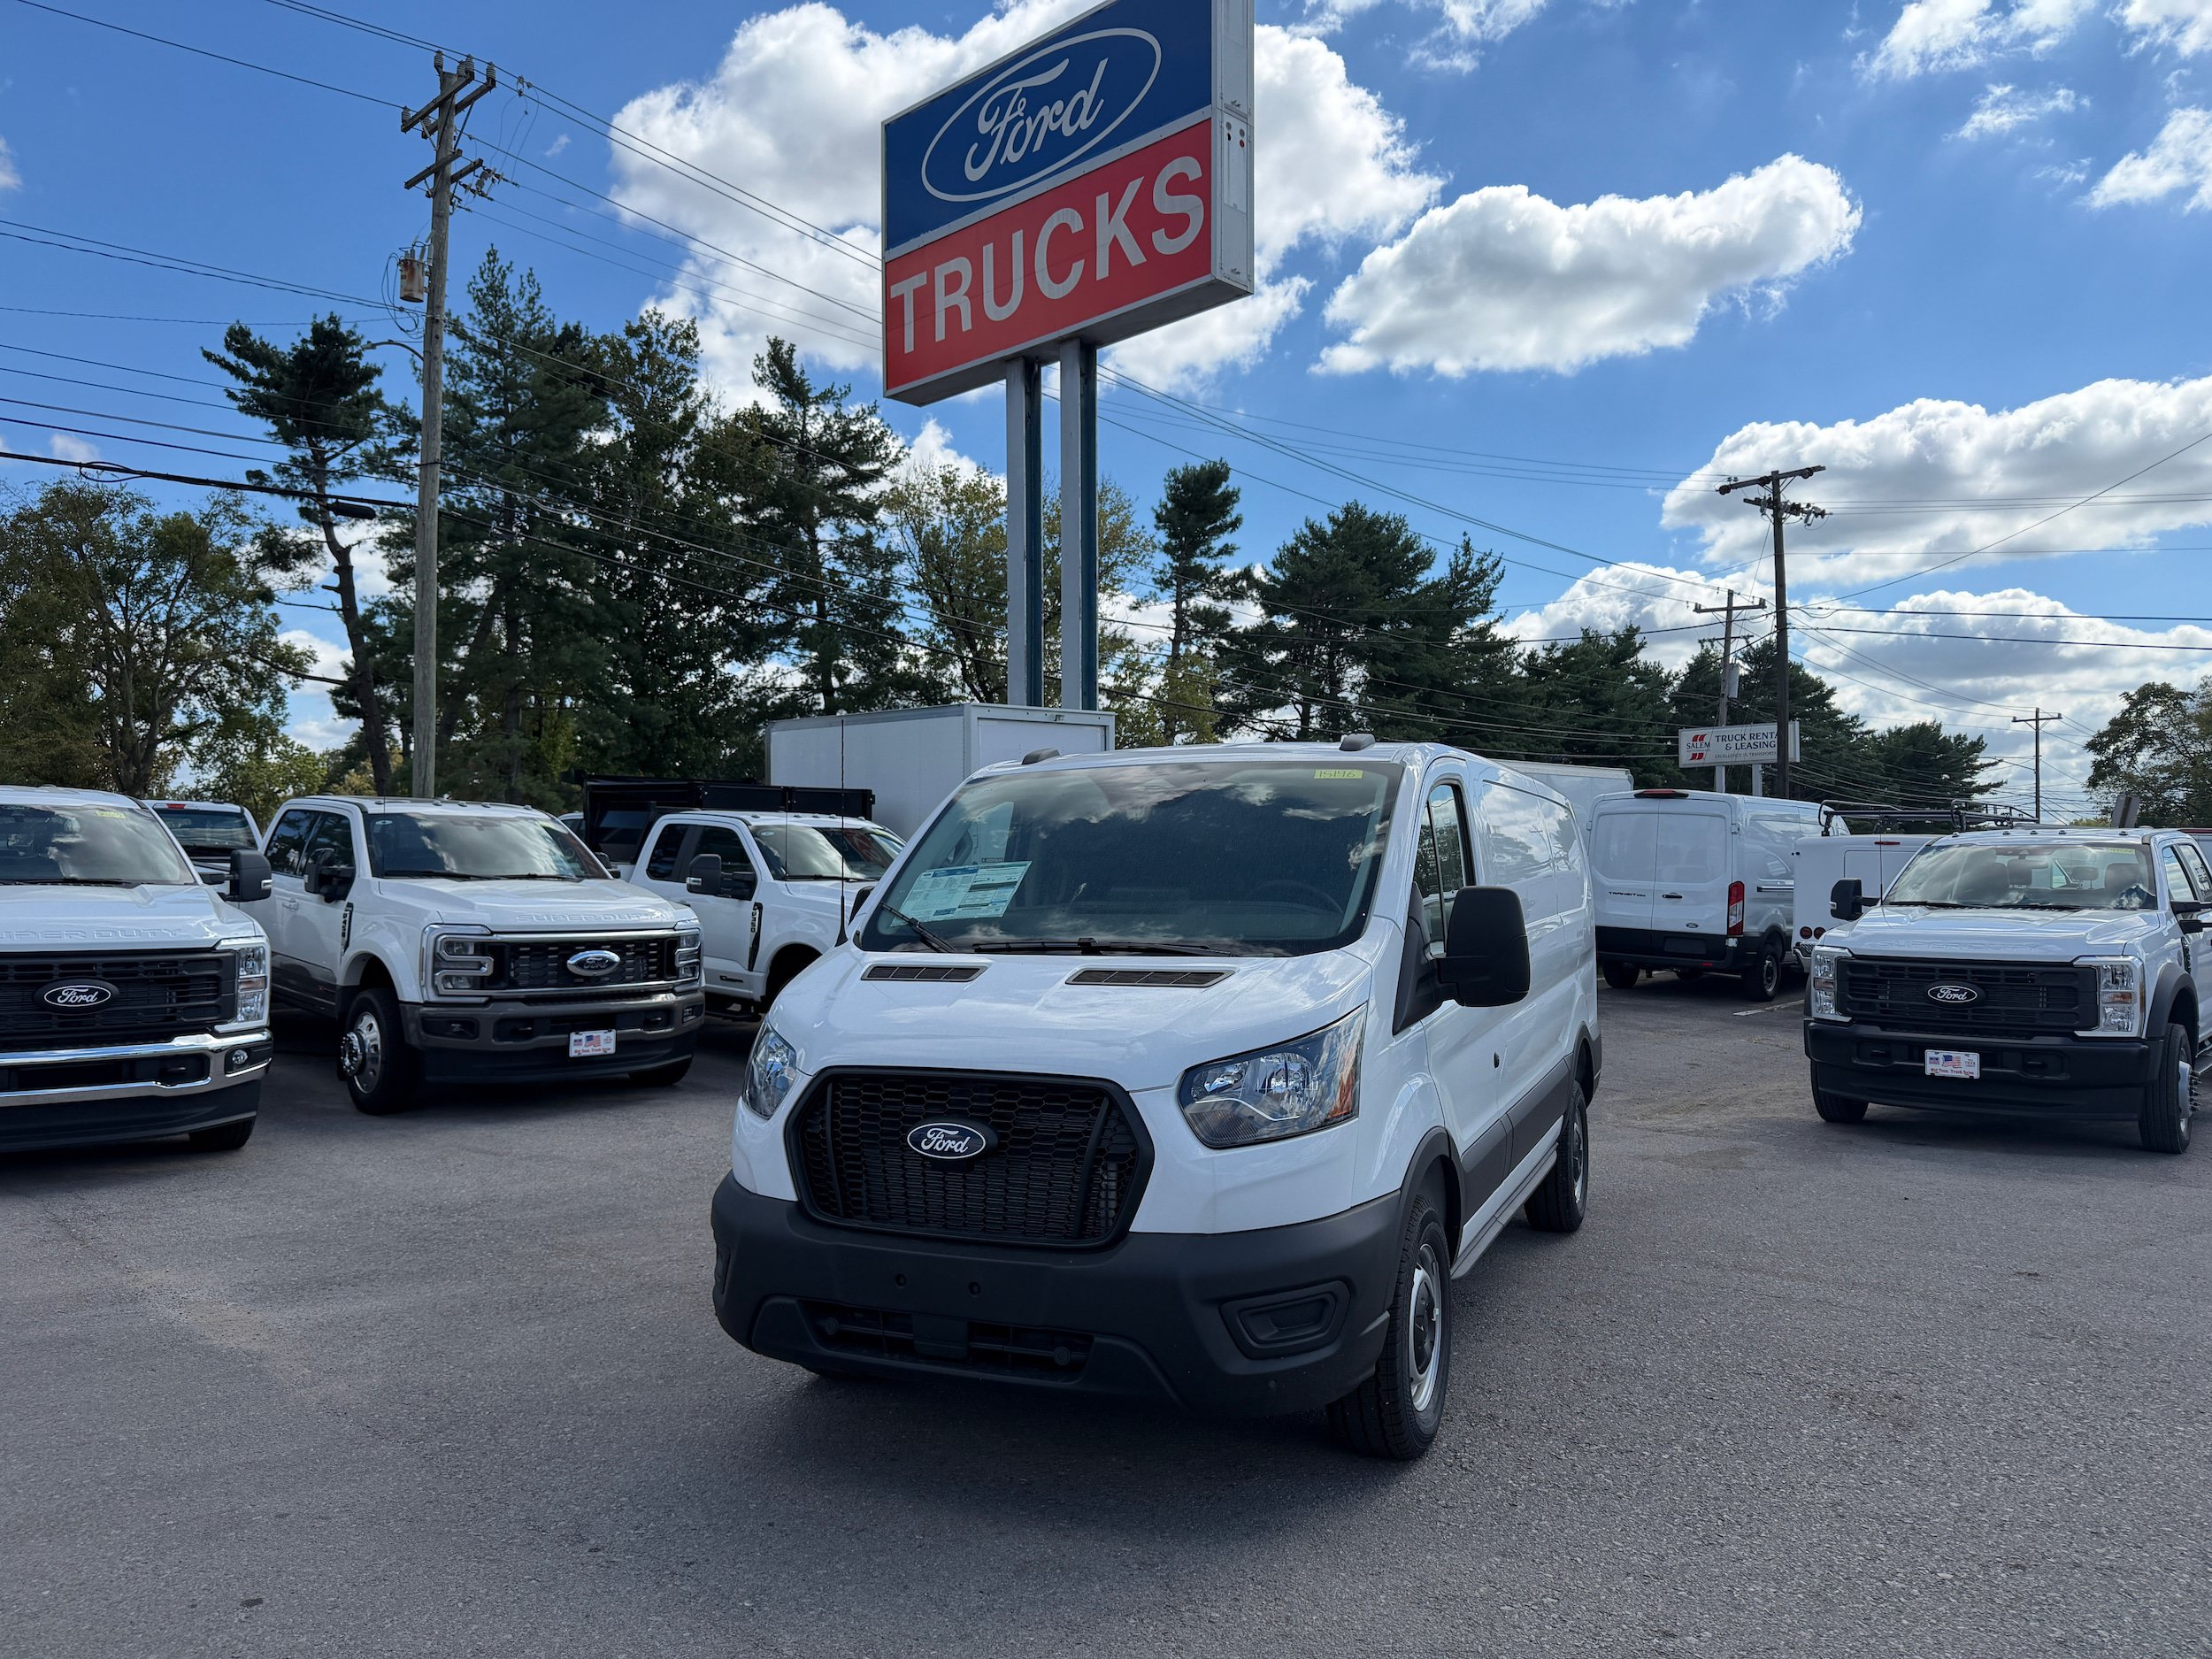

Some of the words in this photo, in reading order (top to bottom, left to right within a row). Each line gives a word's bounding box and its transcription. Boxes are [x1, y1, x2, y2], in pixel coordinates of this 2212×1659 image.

[964, 58, 1110, 182] Ford
[890, 156, 1205, 354] TRUCKS
[1715, 733, 1747, 742] TRUCK
[1735, 741, 1776, 750] LEASING
[93, 928, 182, 940] DUTY
[583, 957, 609, 970] Ford
[57, 987, 100, 1004] Ford
[1937, 987, 1967, 1001] Ford
[920, 1127, 972, 1154] Ford
